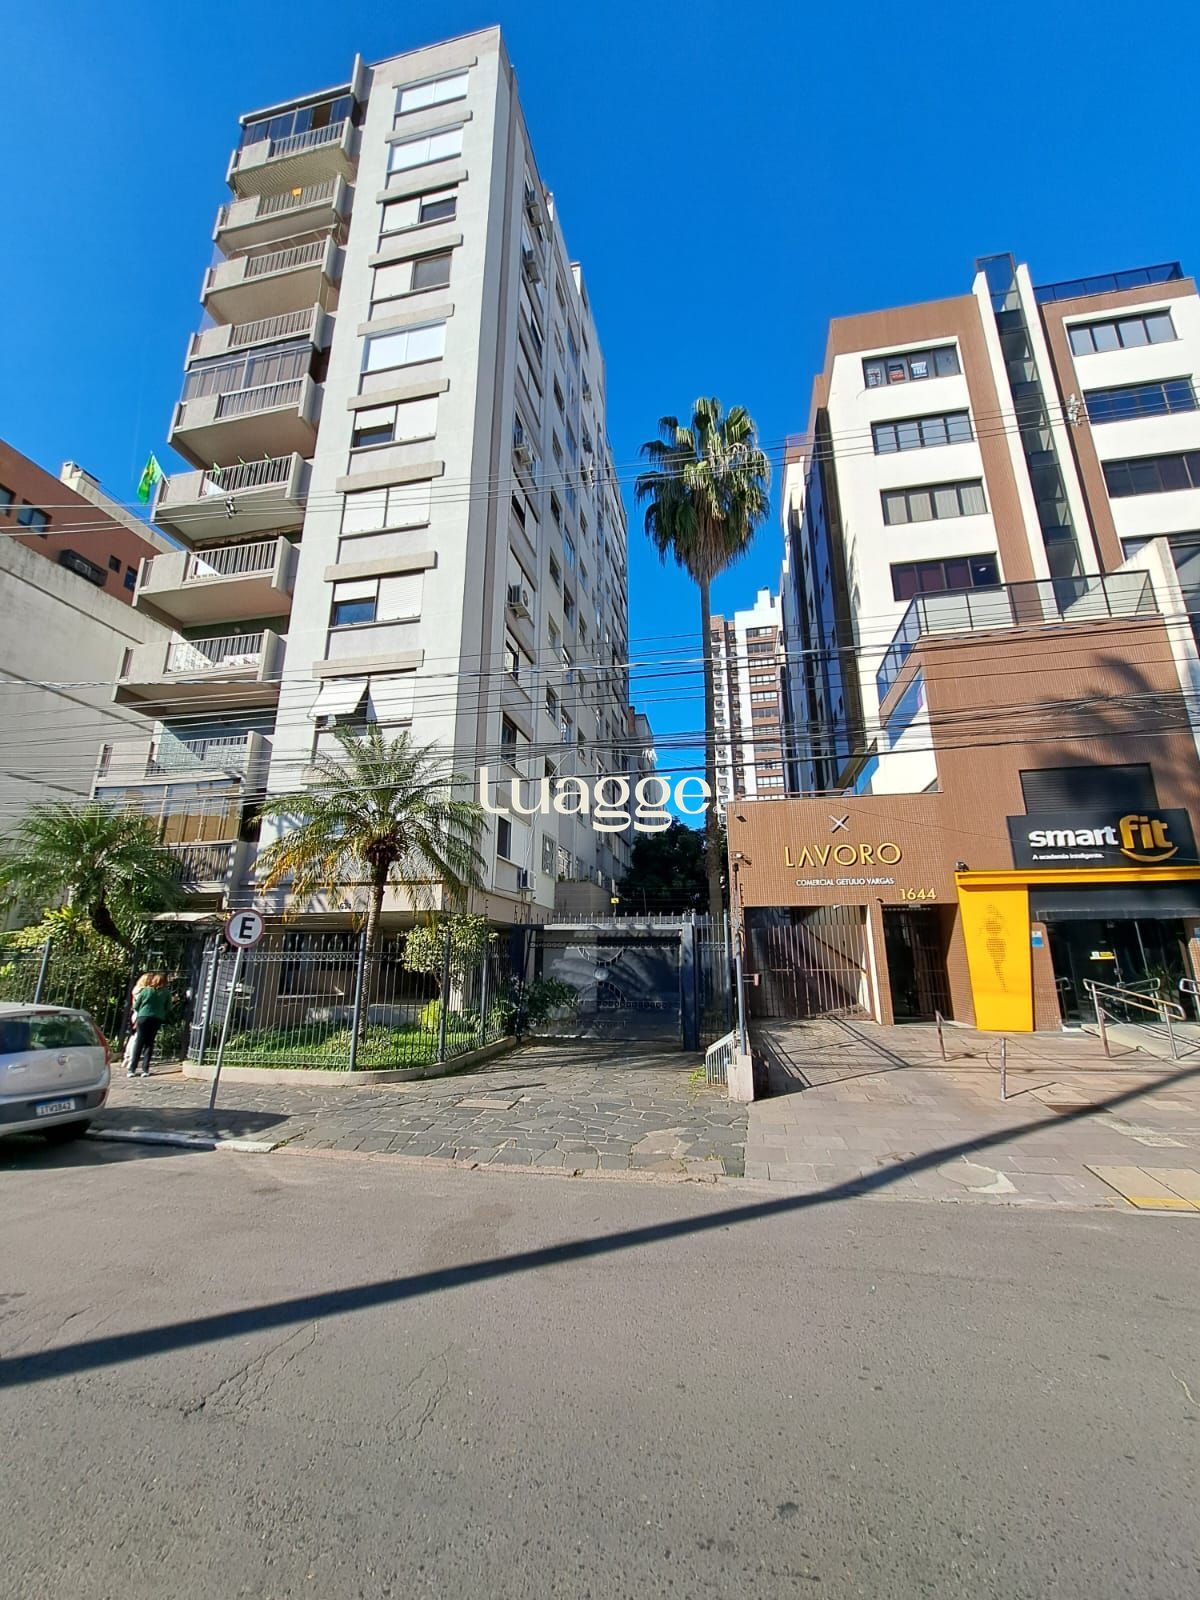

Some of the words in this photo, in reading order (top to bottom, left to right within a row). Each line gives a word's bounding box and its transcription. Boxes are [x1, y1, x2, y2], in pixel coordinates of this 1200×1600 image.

[1028, 825, 1119, 848] smart
[1119, 814, 1173, 850] fit
[784, 842, 902, 867] LAVORO
[796, 878, 834, 887] COMERCIAL
[867, 876, 895, 885] VARGAS
[899, 887, 937, 900] 1644
[239, 916, 255, 940] E
